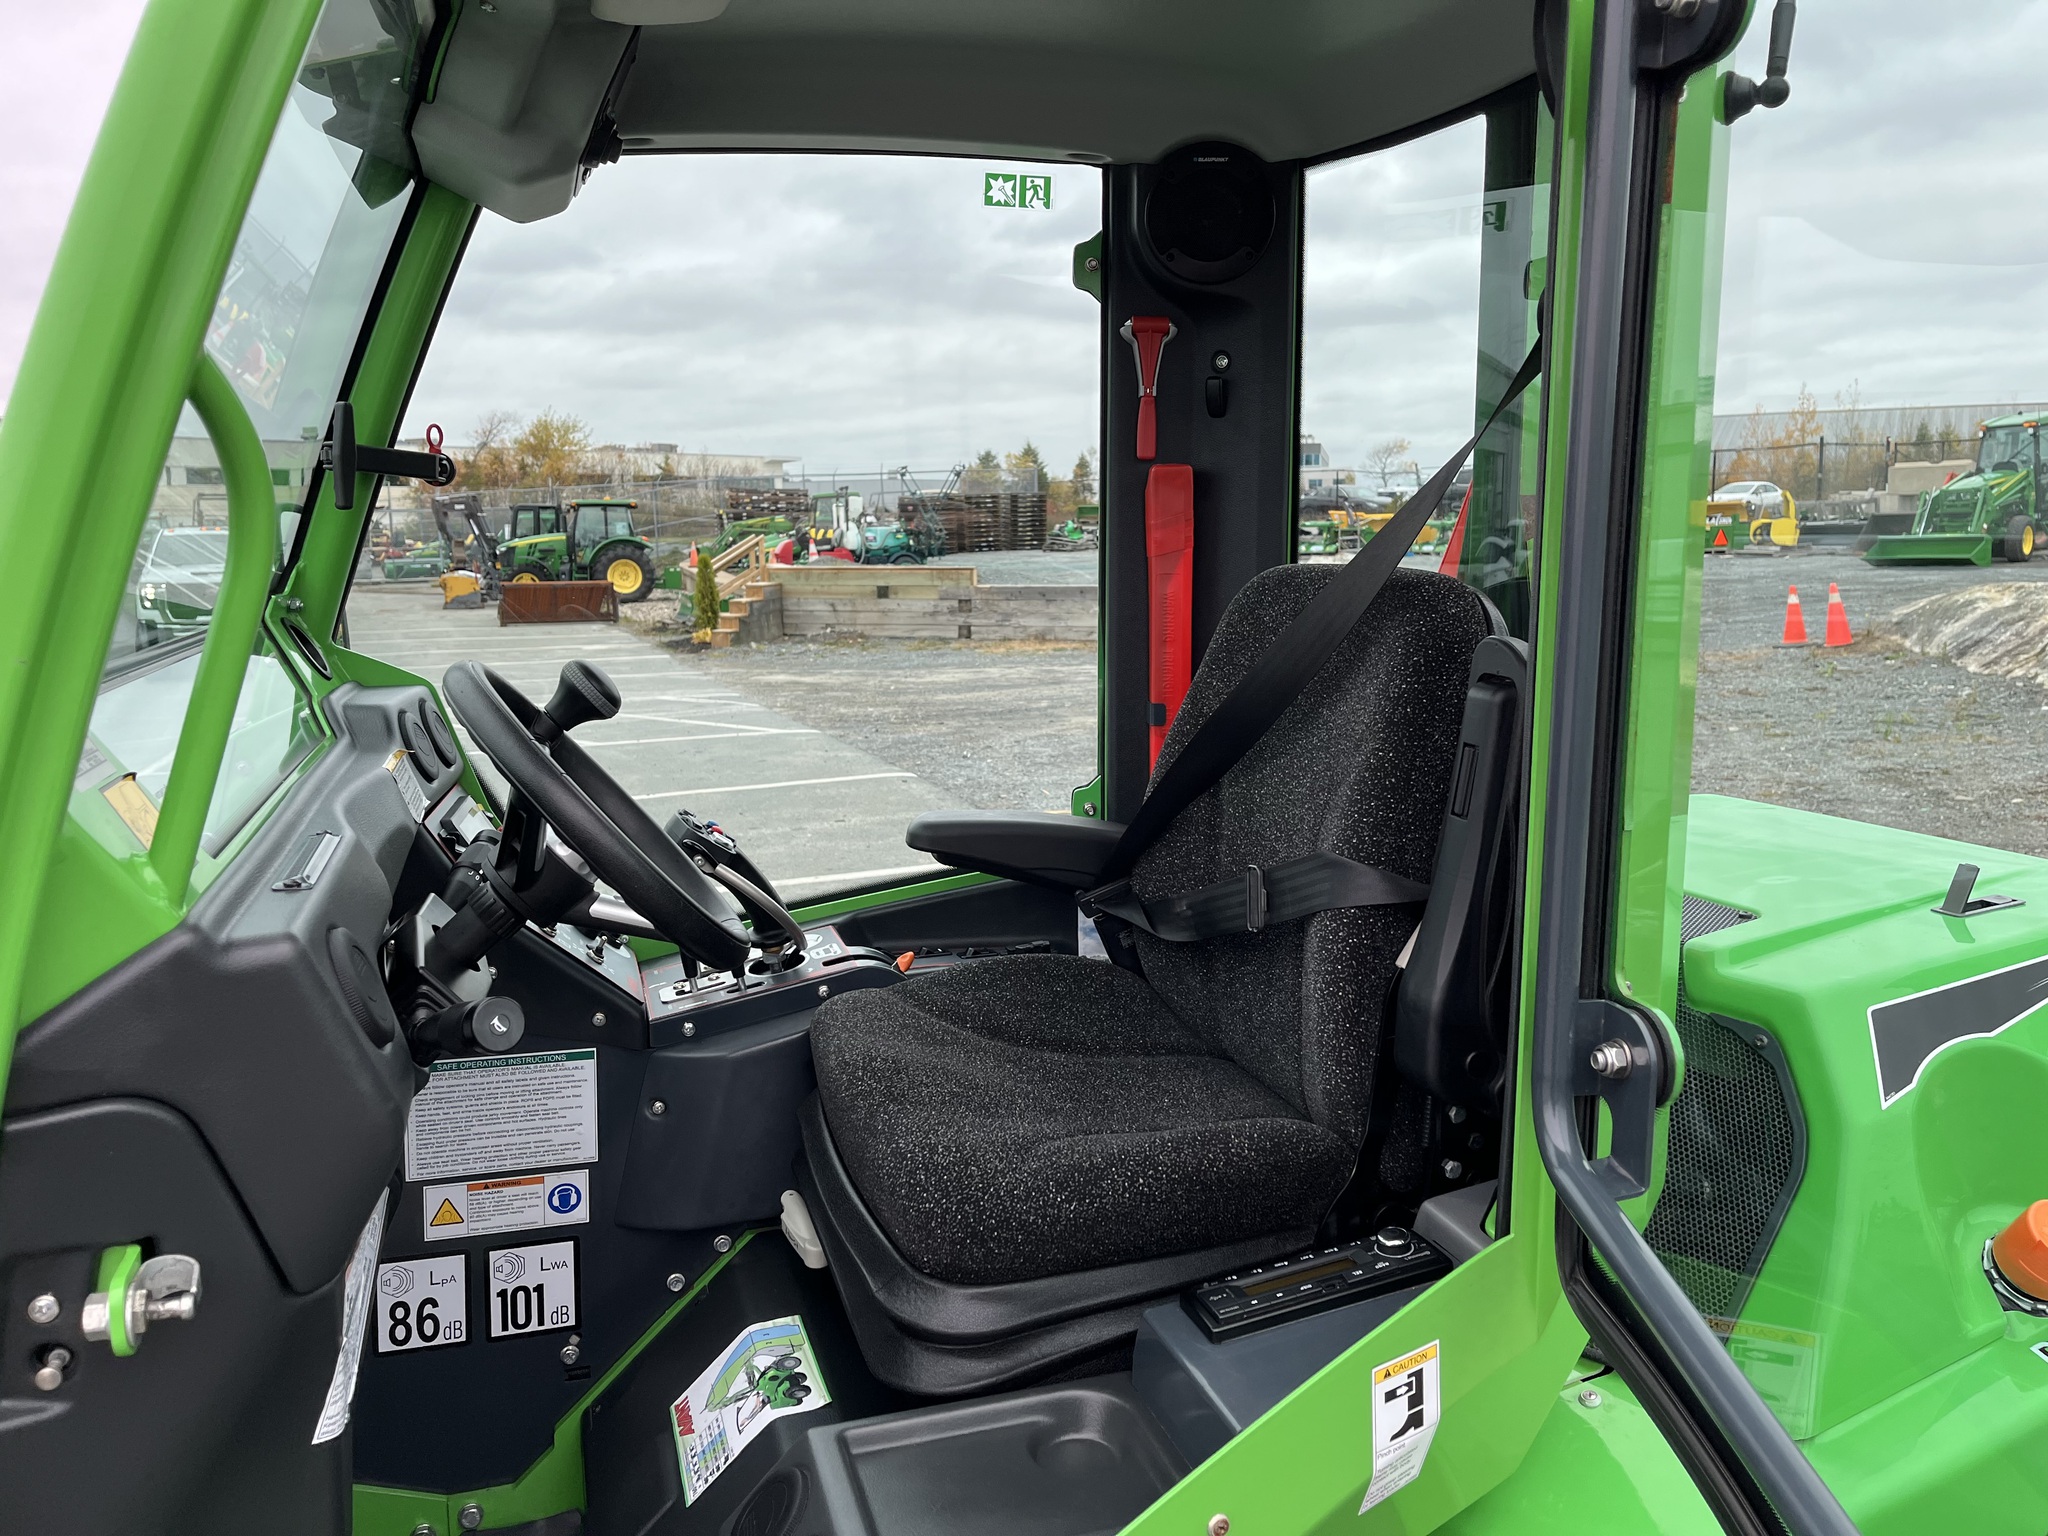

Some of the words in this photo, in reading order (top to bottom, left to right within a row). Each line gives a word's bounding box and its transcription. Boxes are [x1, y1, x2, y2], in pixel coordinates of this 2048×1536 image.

[436, 1062, 457, 1070] SAFE
[459, 1058, 506, 1069] OPERATING
[508, 1054, 566, 1065] INSTRUCTIONS
[541, 1257, 568, 1271] LWA
[497, 1283, 545, 1332] 101
[551, 1305, 570, 1325] dB
[389, 1297, 440, 1347] 86
[443, 1320, 463, 1340] dB
[1393, 1352, 1428, 1374] CAUTION
[675, 1395, 695, 1436] AVANT
[1377, 1450, 1392, 1460] Pinch
